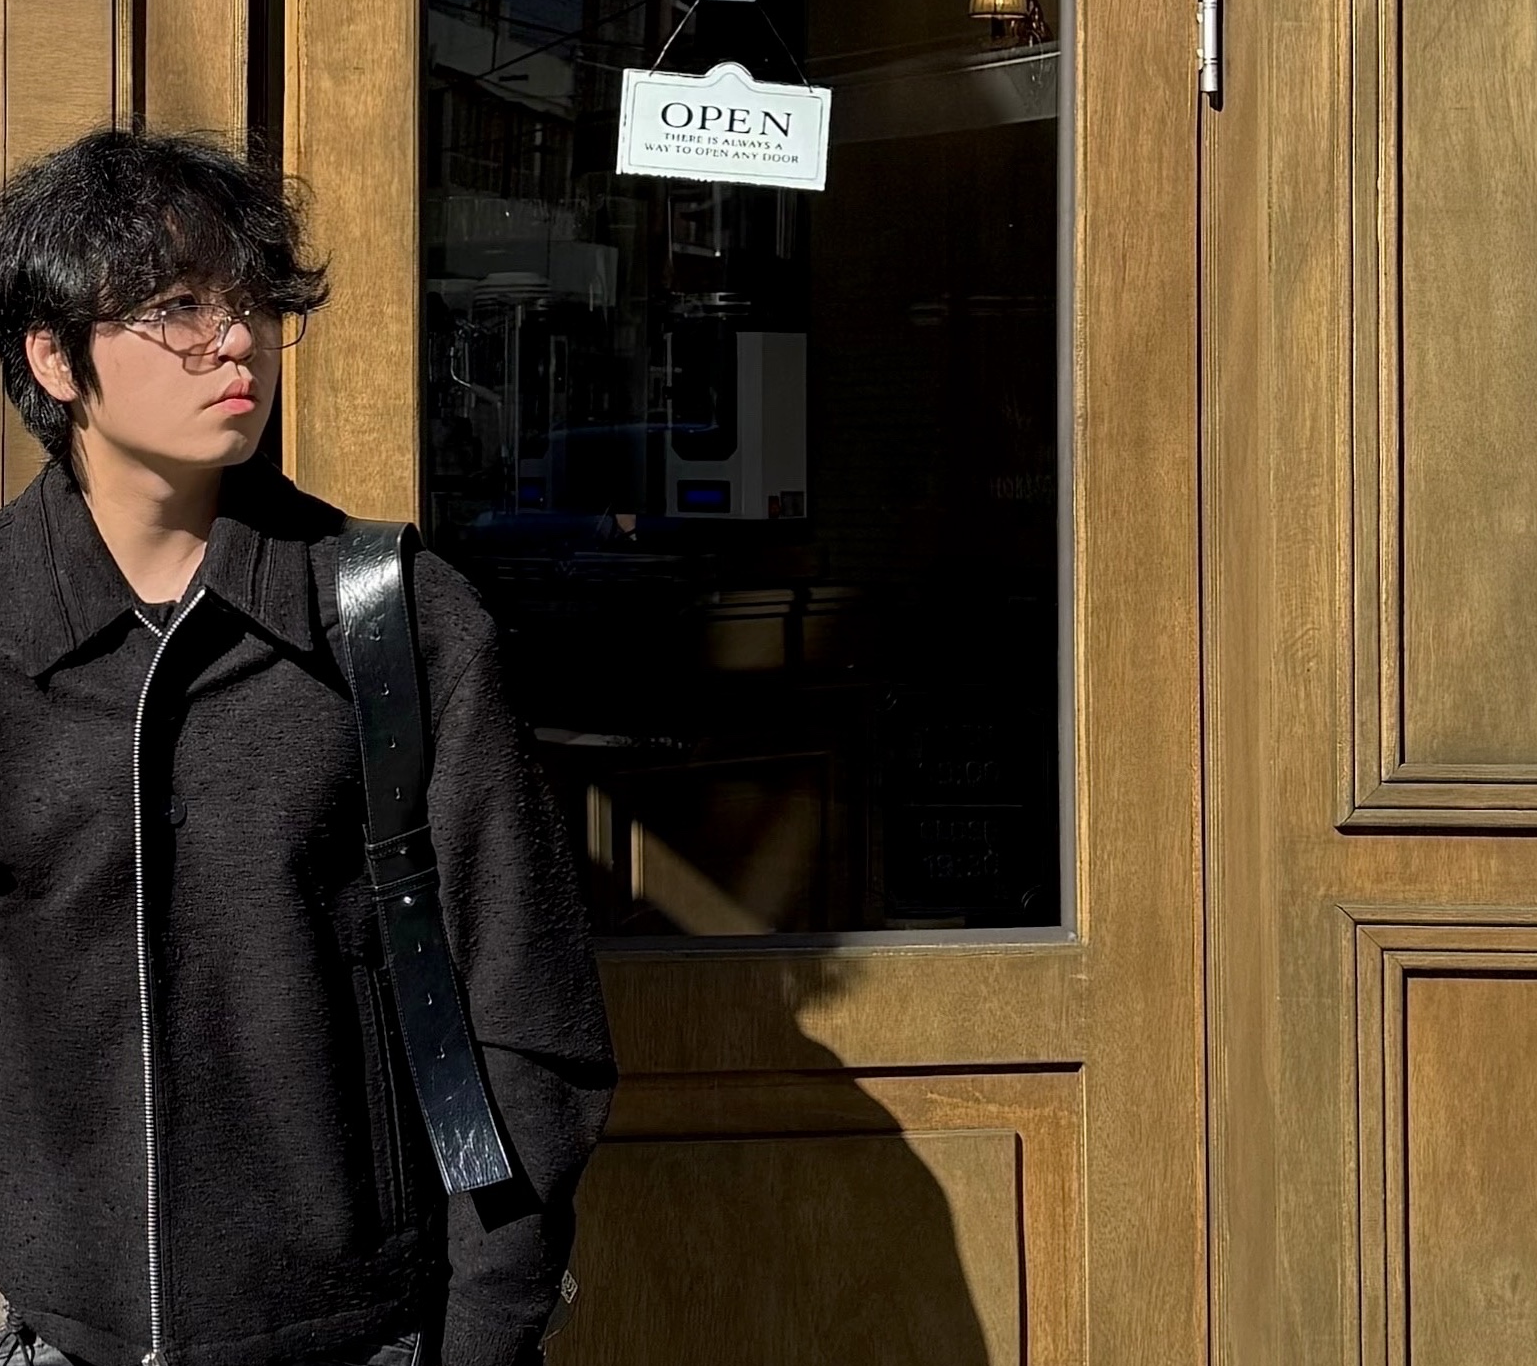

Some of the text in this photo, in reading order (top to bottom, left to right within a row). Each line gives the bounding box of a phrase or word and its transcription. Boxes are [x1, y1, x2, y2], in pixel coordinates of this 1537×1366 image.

[661, 102, 793, 138] OPEN
[664, 132, 703, 145] THERE
[707, 136, 718, 145] IS
[722, 138, 770, 150] ALWAYS
[644, 142, 800, 164] WAY TO OPEN ANY DOOR
